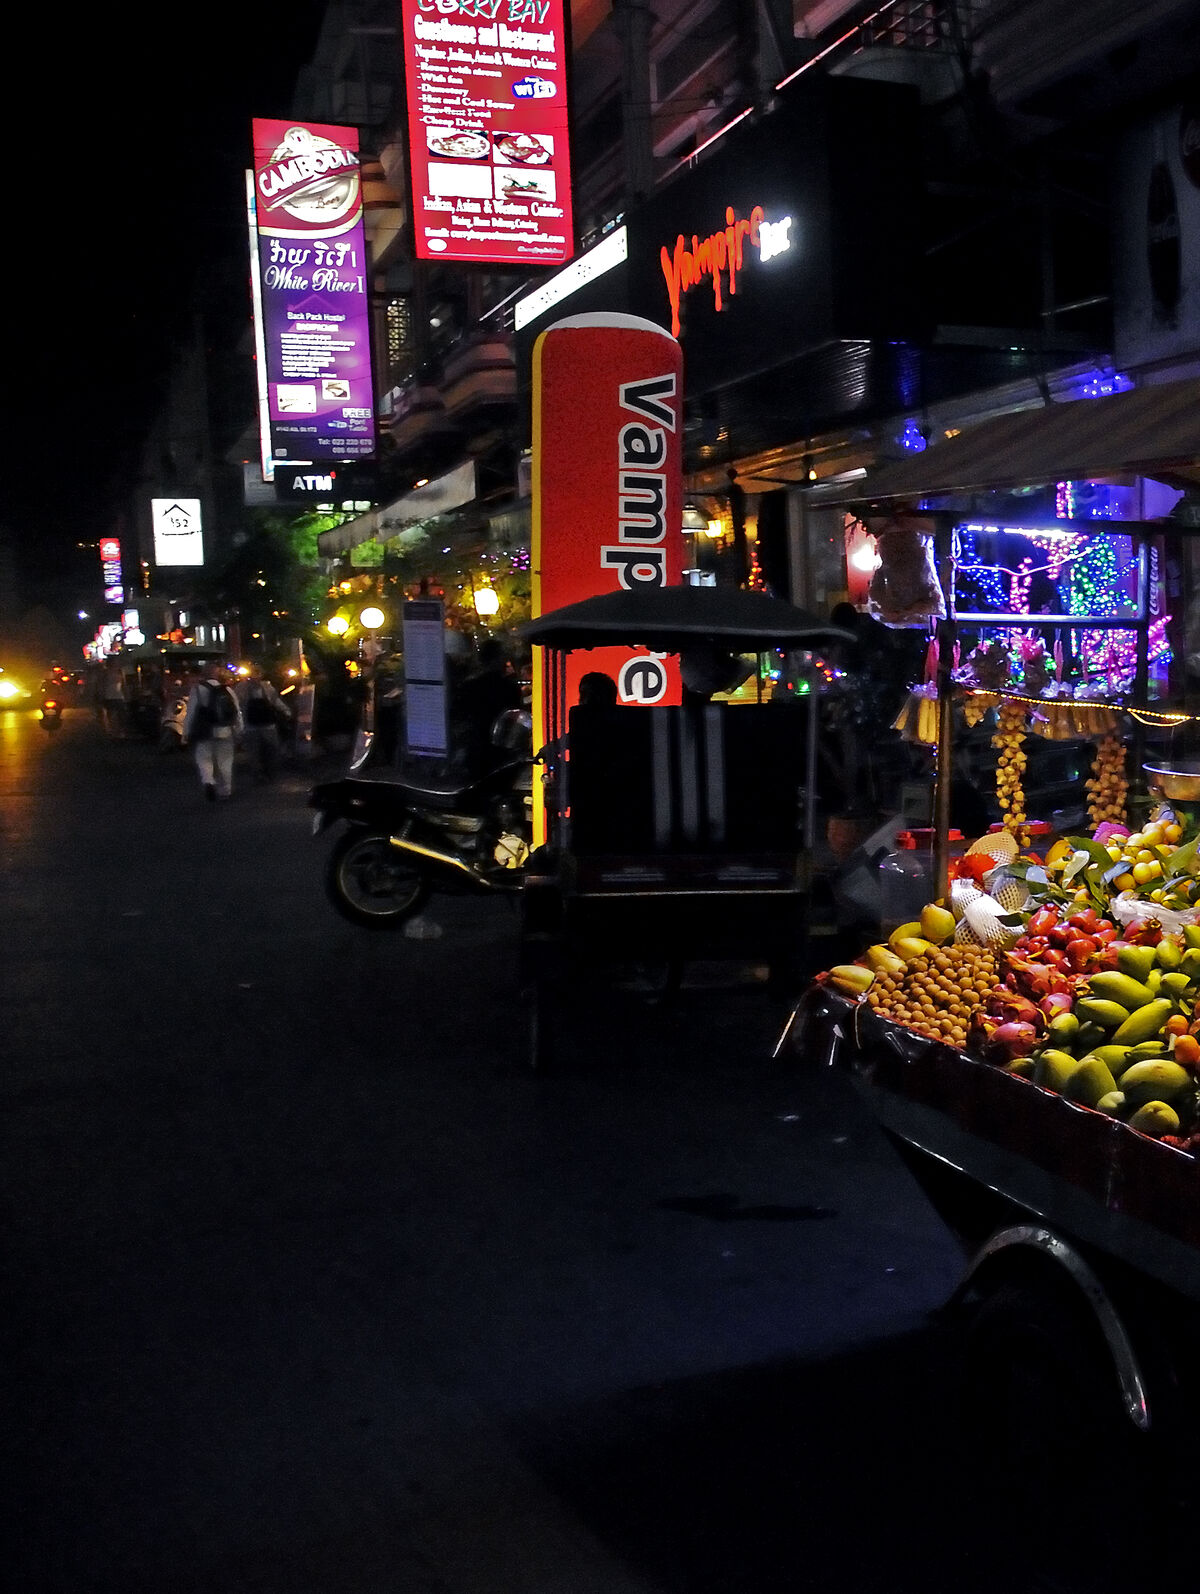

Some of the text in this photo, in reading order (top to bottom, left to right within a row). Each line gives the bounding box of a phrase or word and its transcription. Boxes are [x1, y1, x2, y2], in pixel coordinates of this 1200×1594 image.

[508, 0, 550, 24] BAY
[258, 150, 361, 198] CAMBODIA
[264, 264, 309, 290] White
[312, 267, 357, 292] River
[661, 206, 764, 338] Vampire
[306, 312, 323, 321] Pack
[342, 407, 372, 418] FREE
[293, 476, 332, 490] ATM
[600, 373, 677, 704] Vampe
